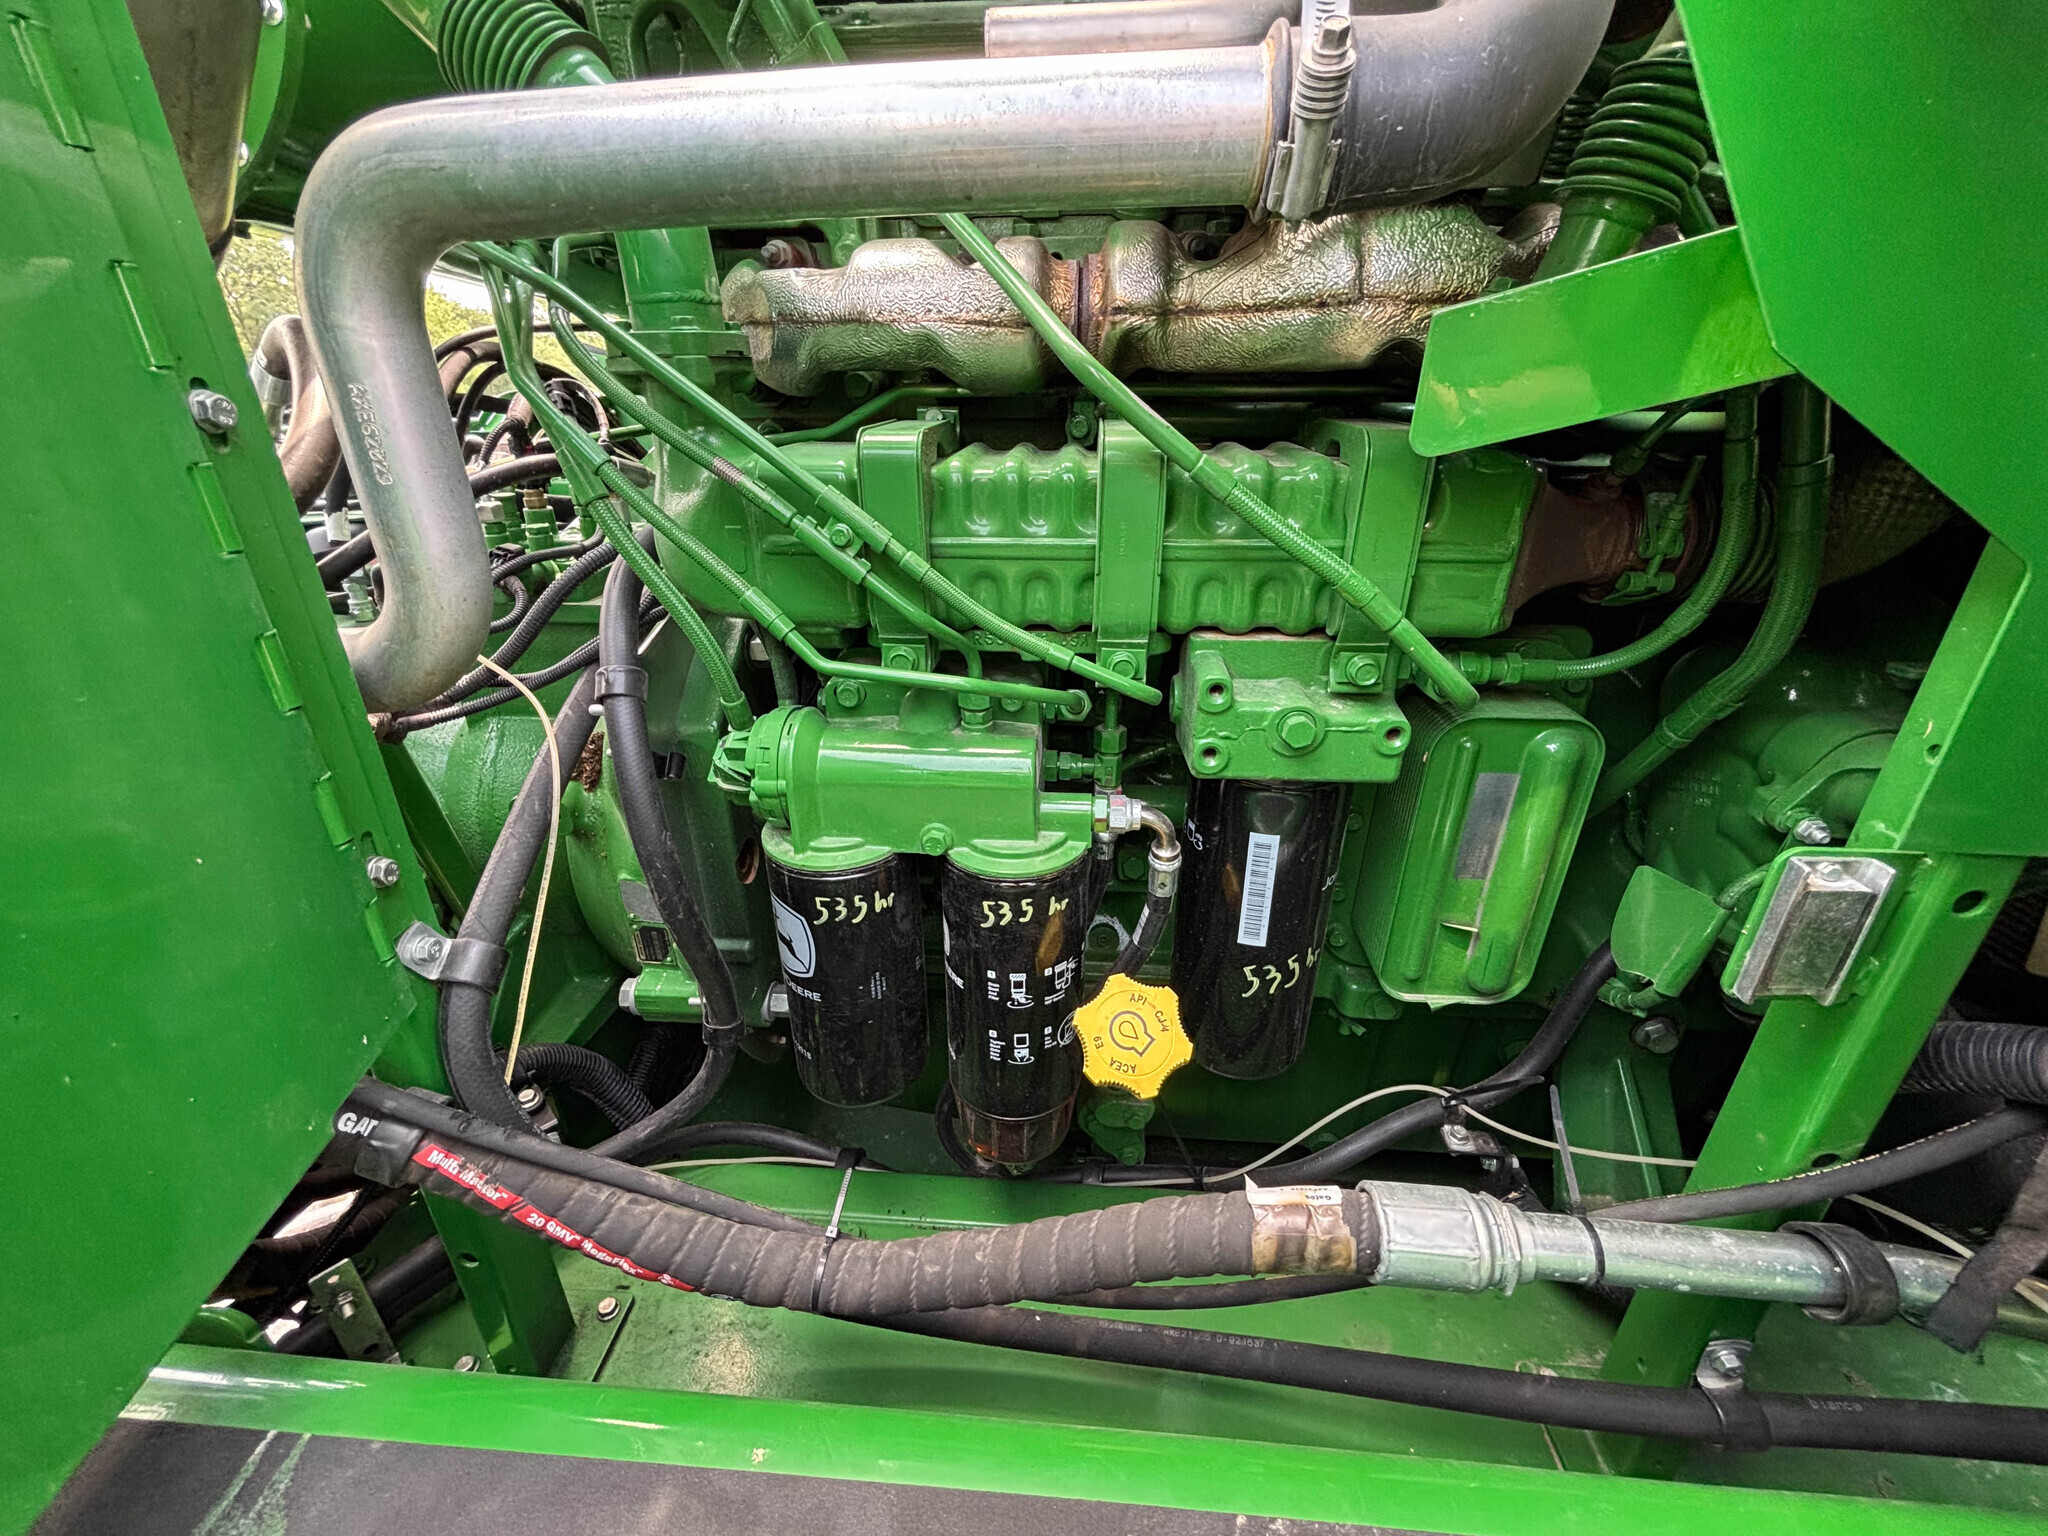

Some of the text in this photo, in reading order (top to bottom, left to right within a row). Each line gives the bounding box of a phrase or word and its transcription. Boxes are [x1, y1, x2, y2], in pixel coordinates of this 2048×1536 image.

[813, 895, 868, 926] 535
[980, 897, 1034, 928] 535
[1242, 953, 1299, 998] 535
[1129, 993, 1147, 1005] API
[1093, 1036, 1137, 1074] ACEA E9
[526, 1212, 546, 1228] 20
